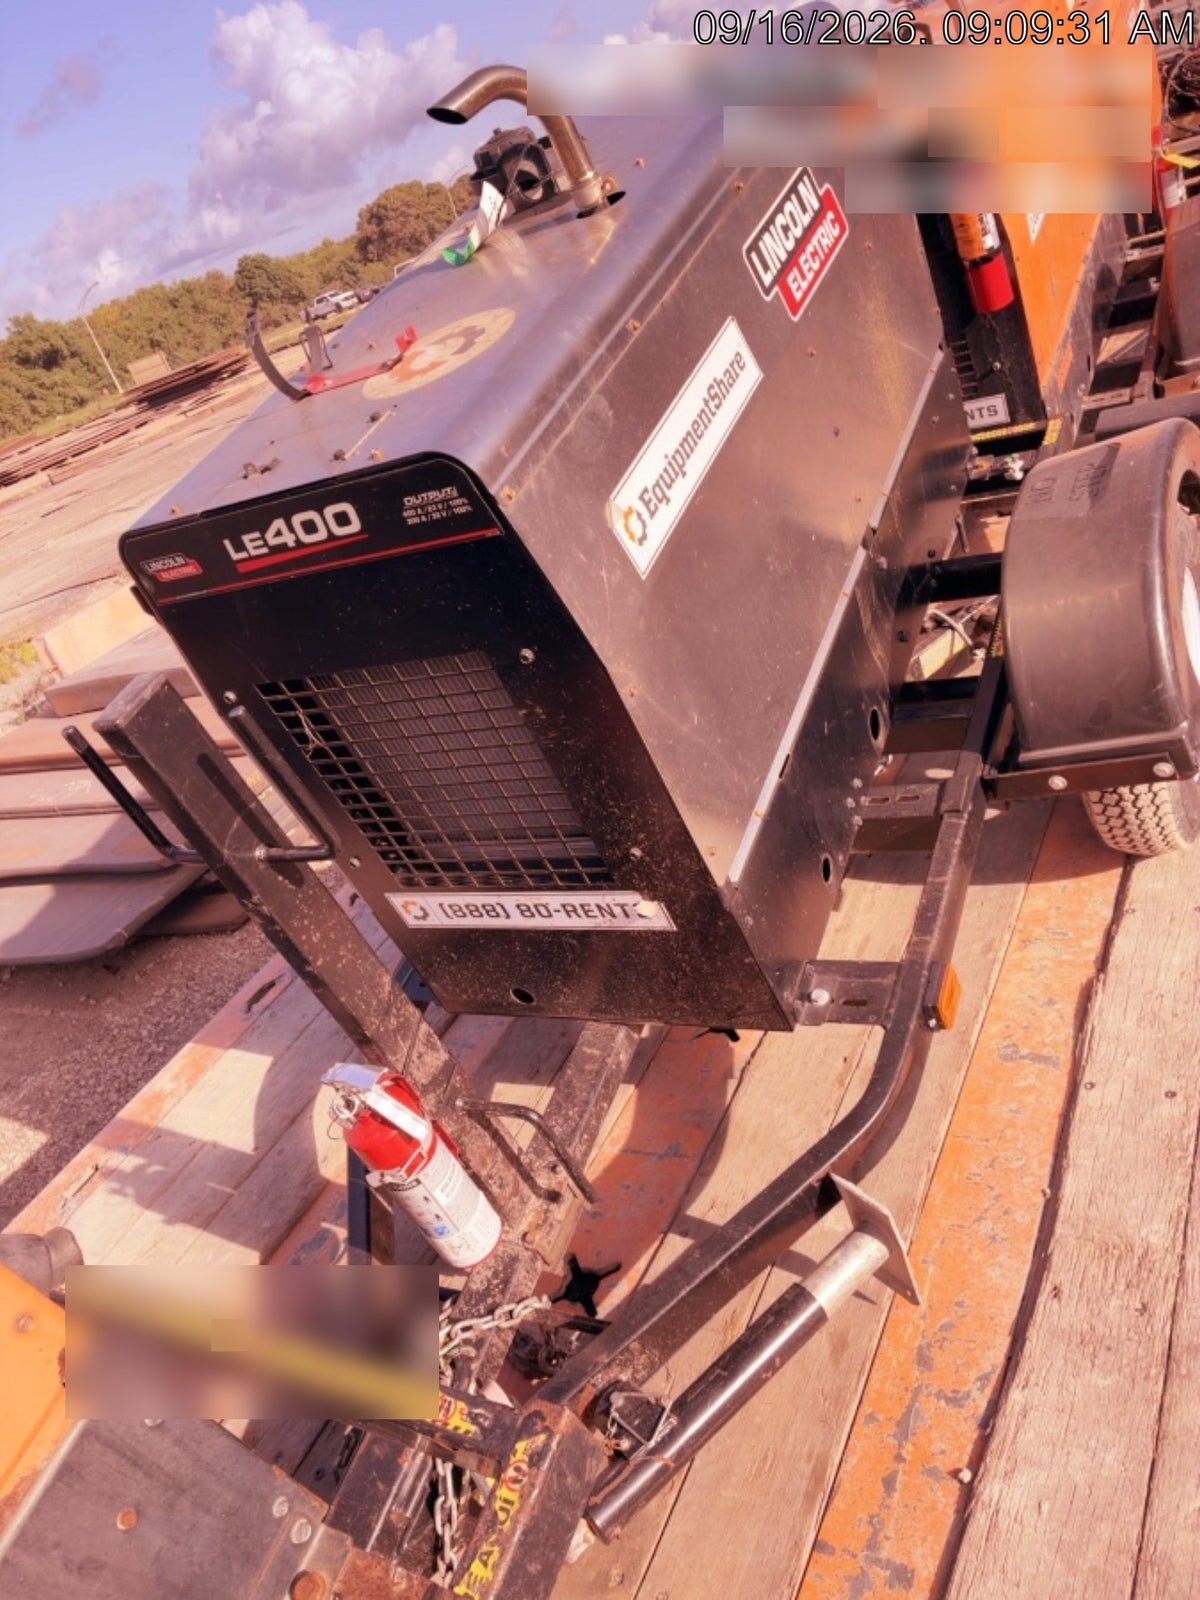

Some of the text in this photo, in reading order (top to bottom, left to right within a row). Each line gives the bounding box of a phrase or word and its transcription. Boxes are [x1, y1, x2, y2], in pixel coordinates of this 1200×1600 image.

[750, 175, 820, 288] LINCOLN
[786, 210, 840, 302] ELECTRIC
[637, 351, 747, 521] EquipmentShare
[223, 502, 362, 561] LE400
[438, 902, 510, 919] (888)
